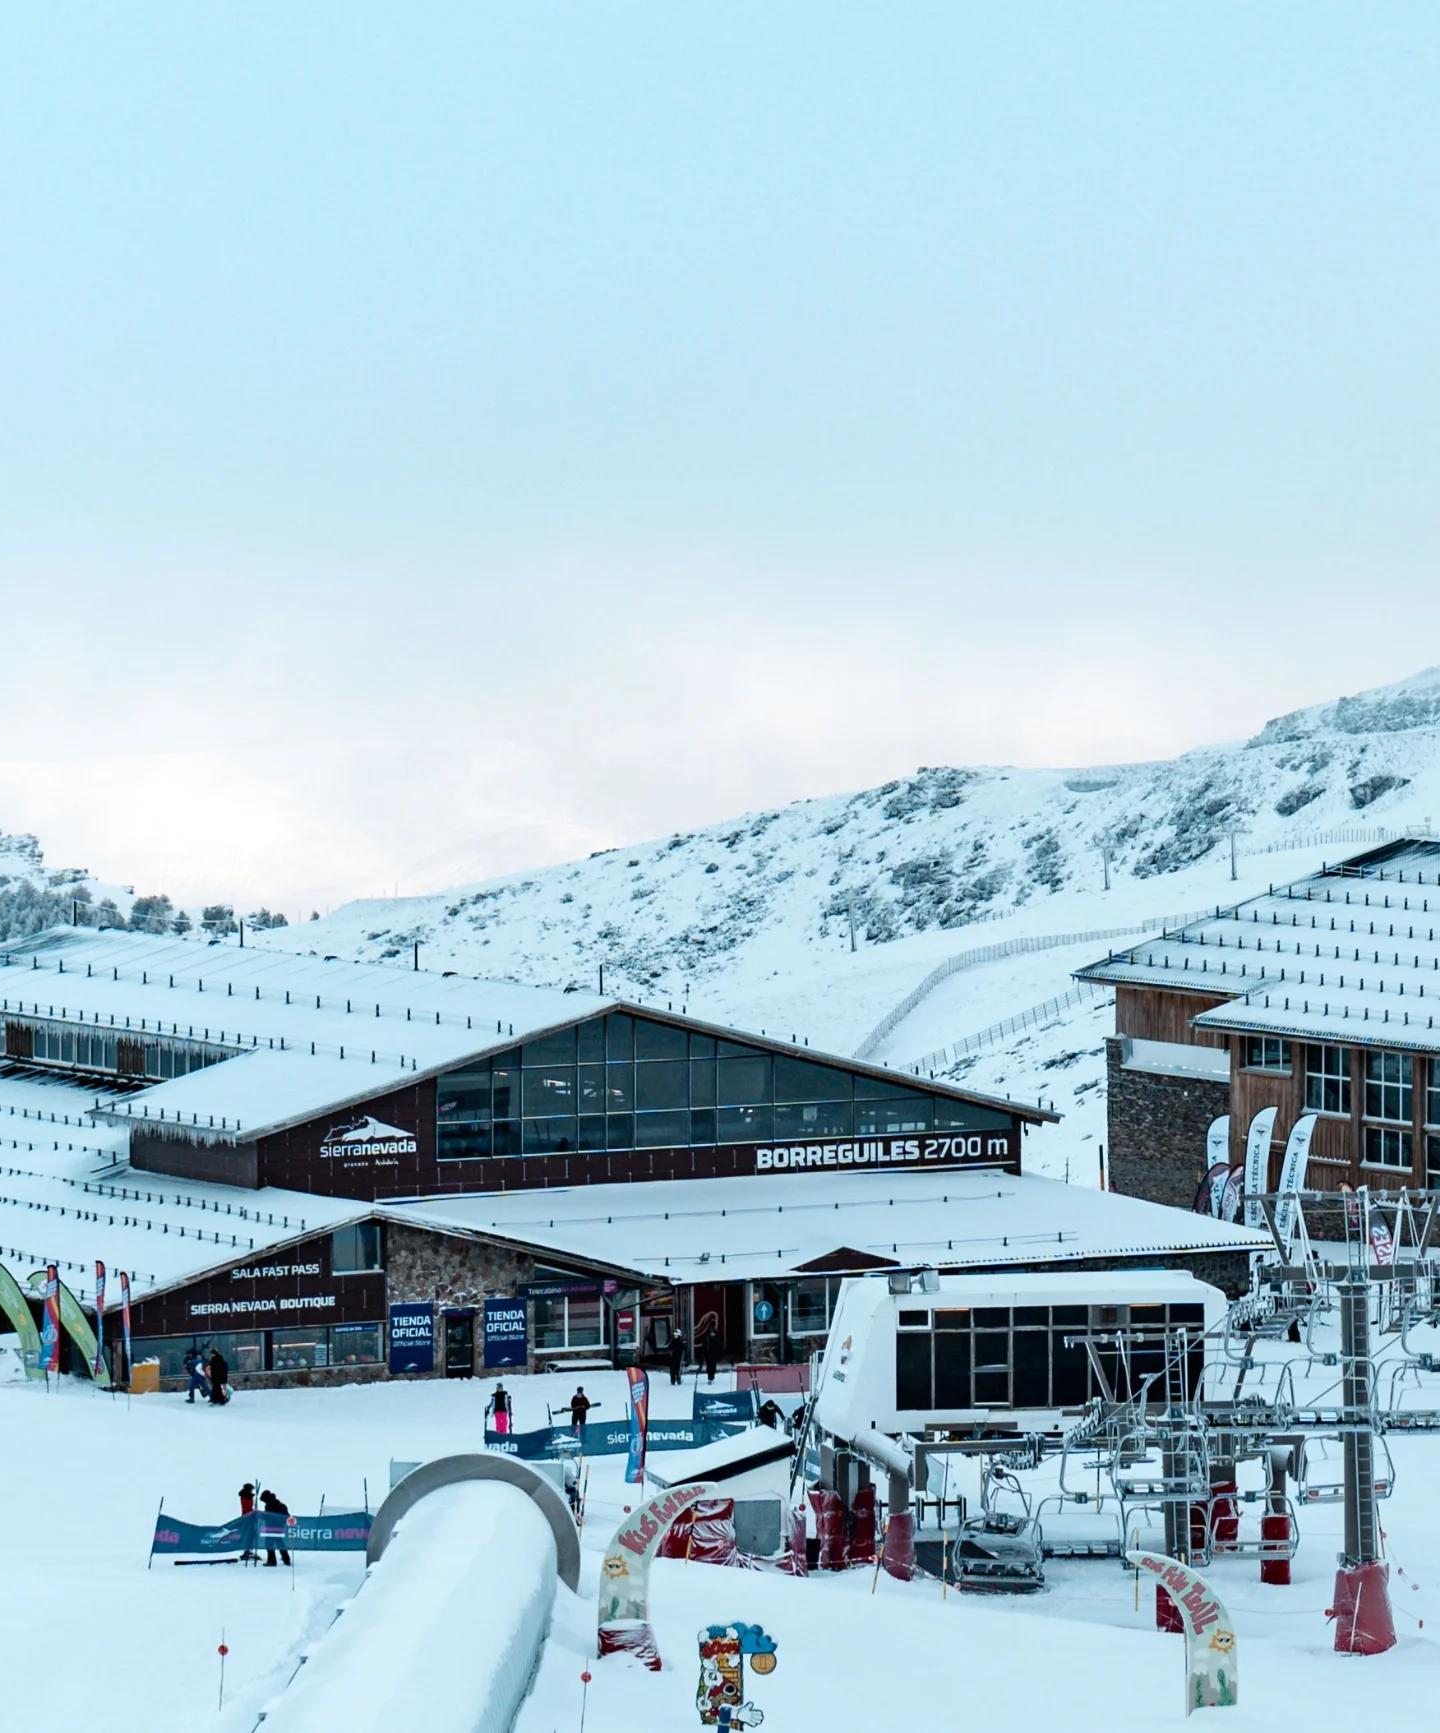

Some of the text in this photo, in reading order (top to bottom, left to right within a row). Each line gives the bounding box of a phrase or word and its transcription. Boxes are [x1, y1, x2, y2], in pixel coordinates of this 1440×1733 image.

[320, 1139, 417, 1158] sierranevada
[756, 1137, 1008, 1169] BORREGUILES 2700 m
[1250, 1184, 1259, 1221] ESCULA
[232, 1264, 320, 1279] SALA FAST PASS
[190, 1296, 336, 1315] SIERRA NEVADA BOUTIQUE
[392, 1316, 431, 1327] TIENDA
[486, 1310, 525, 1321] TIENDA
[392, 1327, 432, 1338] OFICIAL
[486, 1321, 526, 1332] OFICIAL
[287, 1524, 333, 1541] sierra
